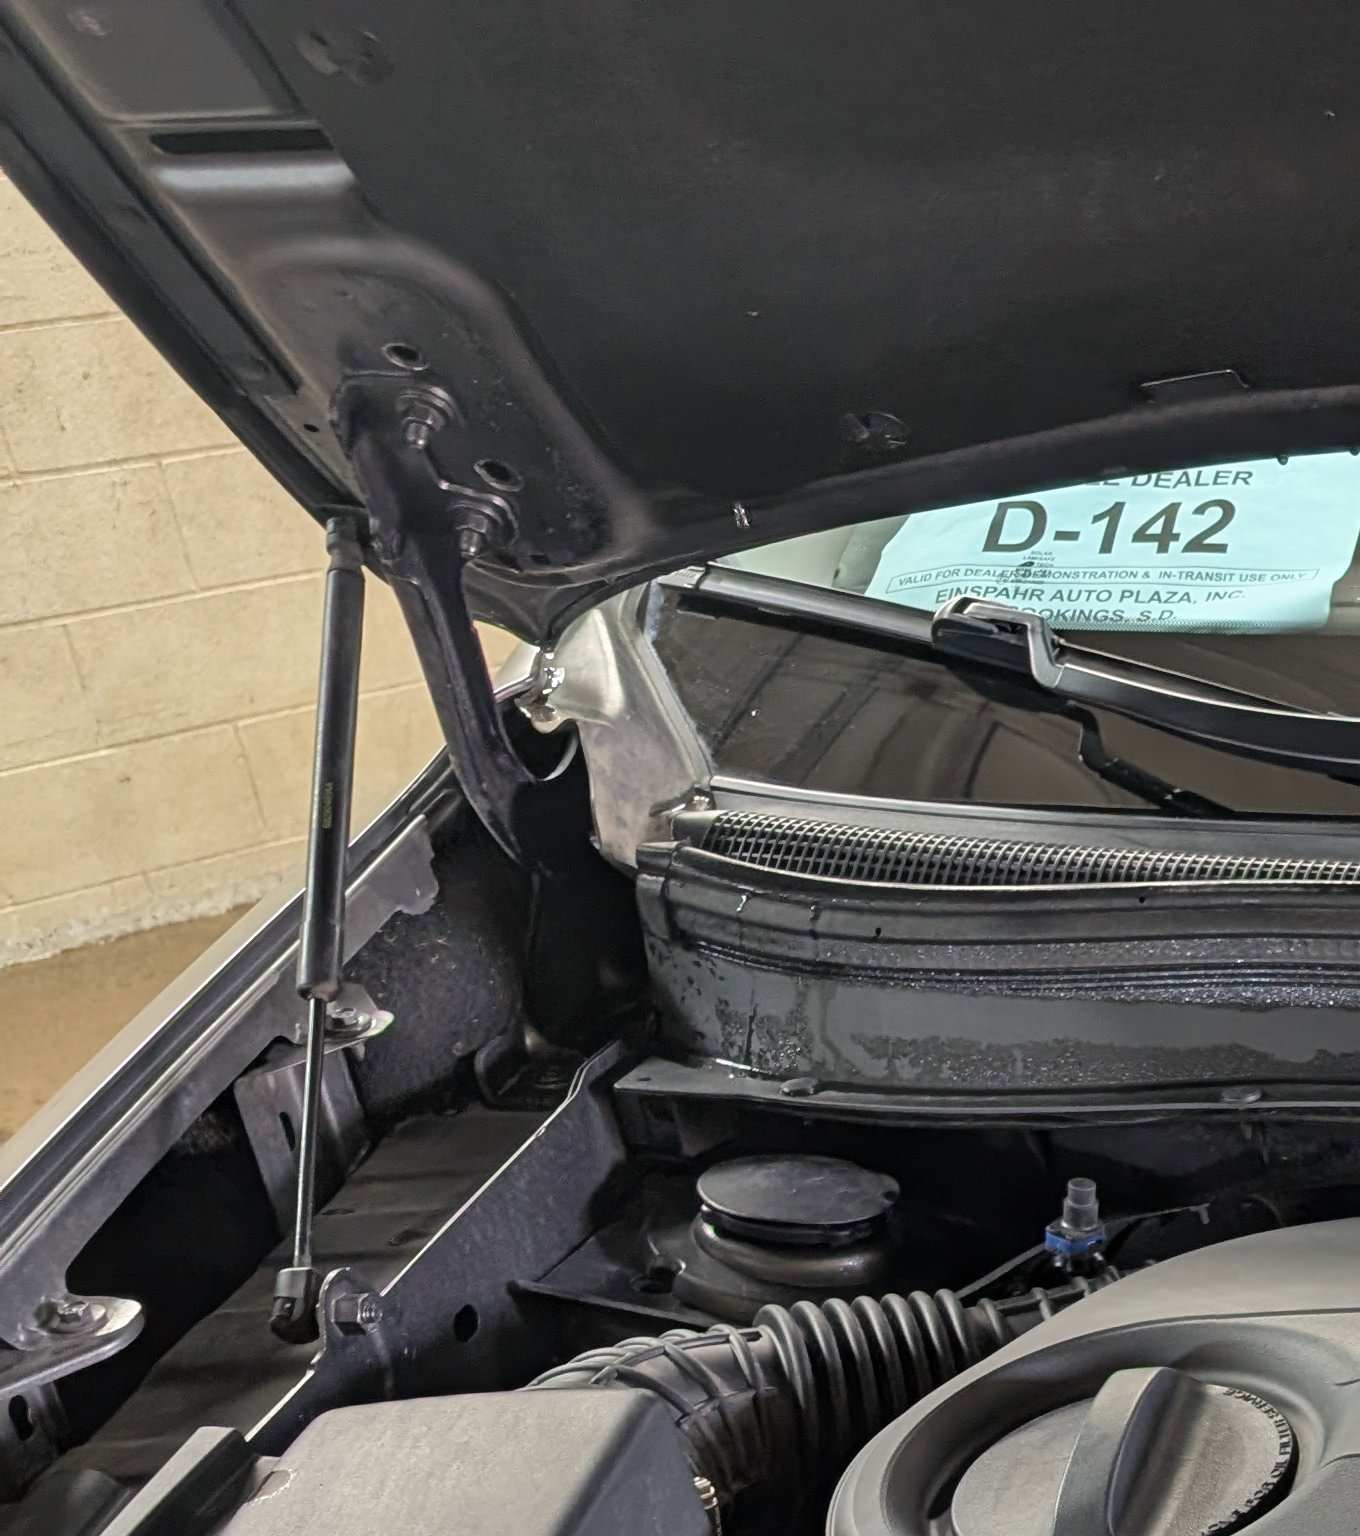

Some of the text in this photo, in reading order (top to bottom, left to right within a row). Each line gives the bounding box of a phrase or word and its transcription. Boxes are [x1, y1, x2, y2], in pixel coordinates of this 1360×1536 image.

[1131, 470, 1253, 489] DEALER
[982, 498, 1236, 555] D-142
[898, 568, 1308, 587] VALID FOR DEALER DEMONSTRATION & IN-TRANSIT USE ONLY
[935, 585, 1246, 605] EINSPAHR AUTO PLAZA, INC.
[1136, 609, 1177, 623] S.D.
[1222, 1388, 1279, 1420] SERVICE
